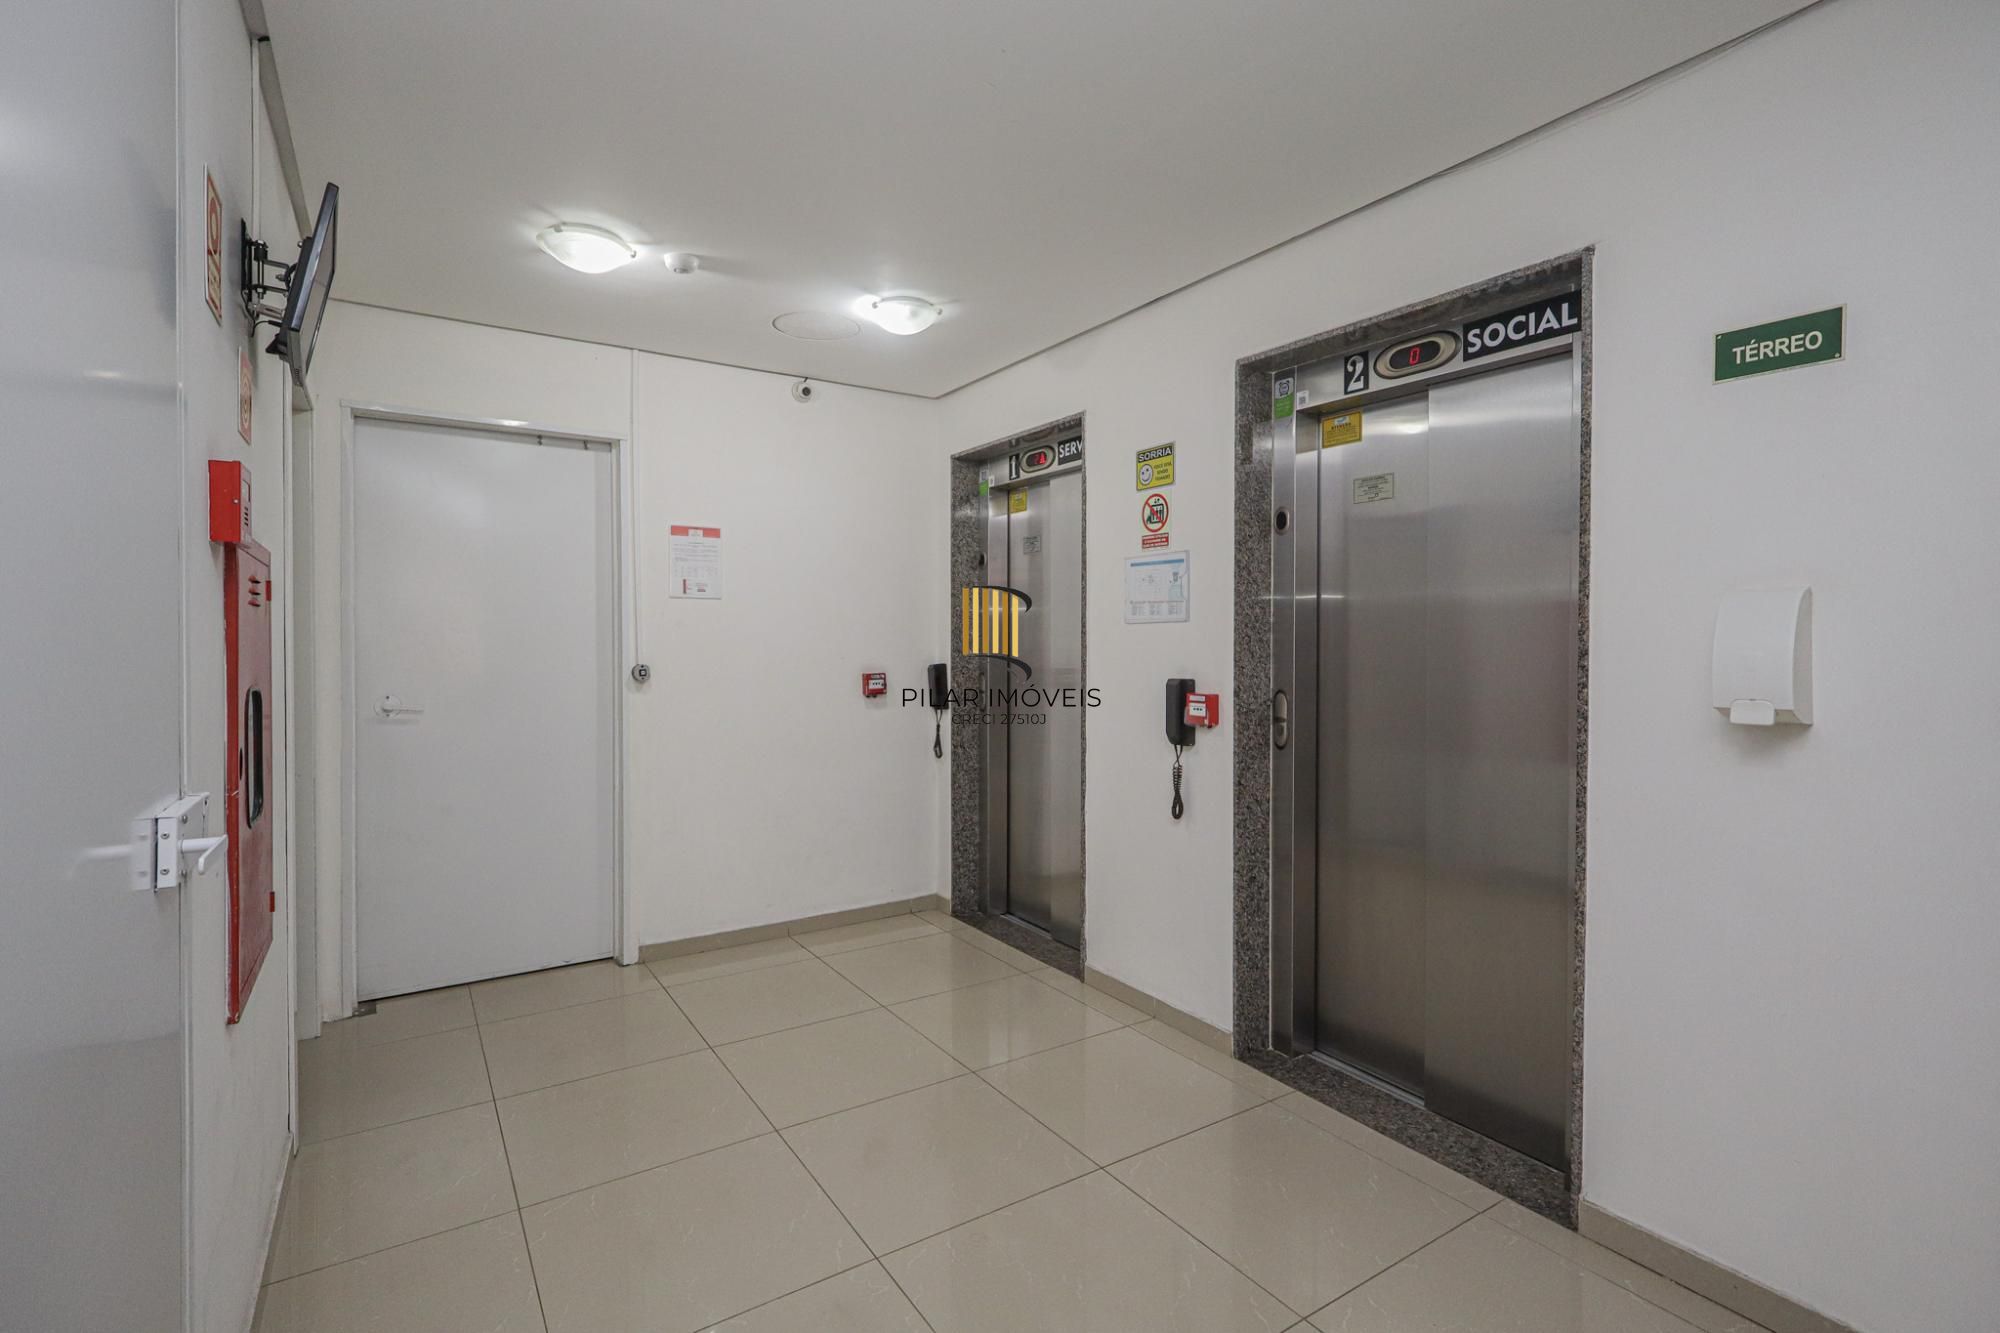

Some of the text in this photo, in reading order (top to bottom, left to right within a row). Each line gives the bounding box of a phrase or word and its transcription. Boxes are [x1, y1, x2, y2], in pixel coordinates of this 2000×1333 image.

[1467, 302, 1578, 353] SOCIAL
[1408, 346, 1421, 366] 0
[1732, 330, 1823, 365] TÉRREO
[1346, 354, 1365, 392] 2
[1010, 455, 1018, 479] 1
[1138, 446, 1172, 462] SORRIA
